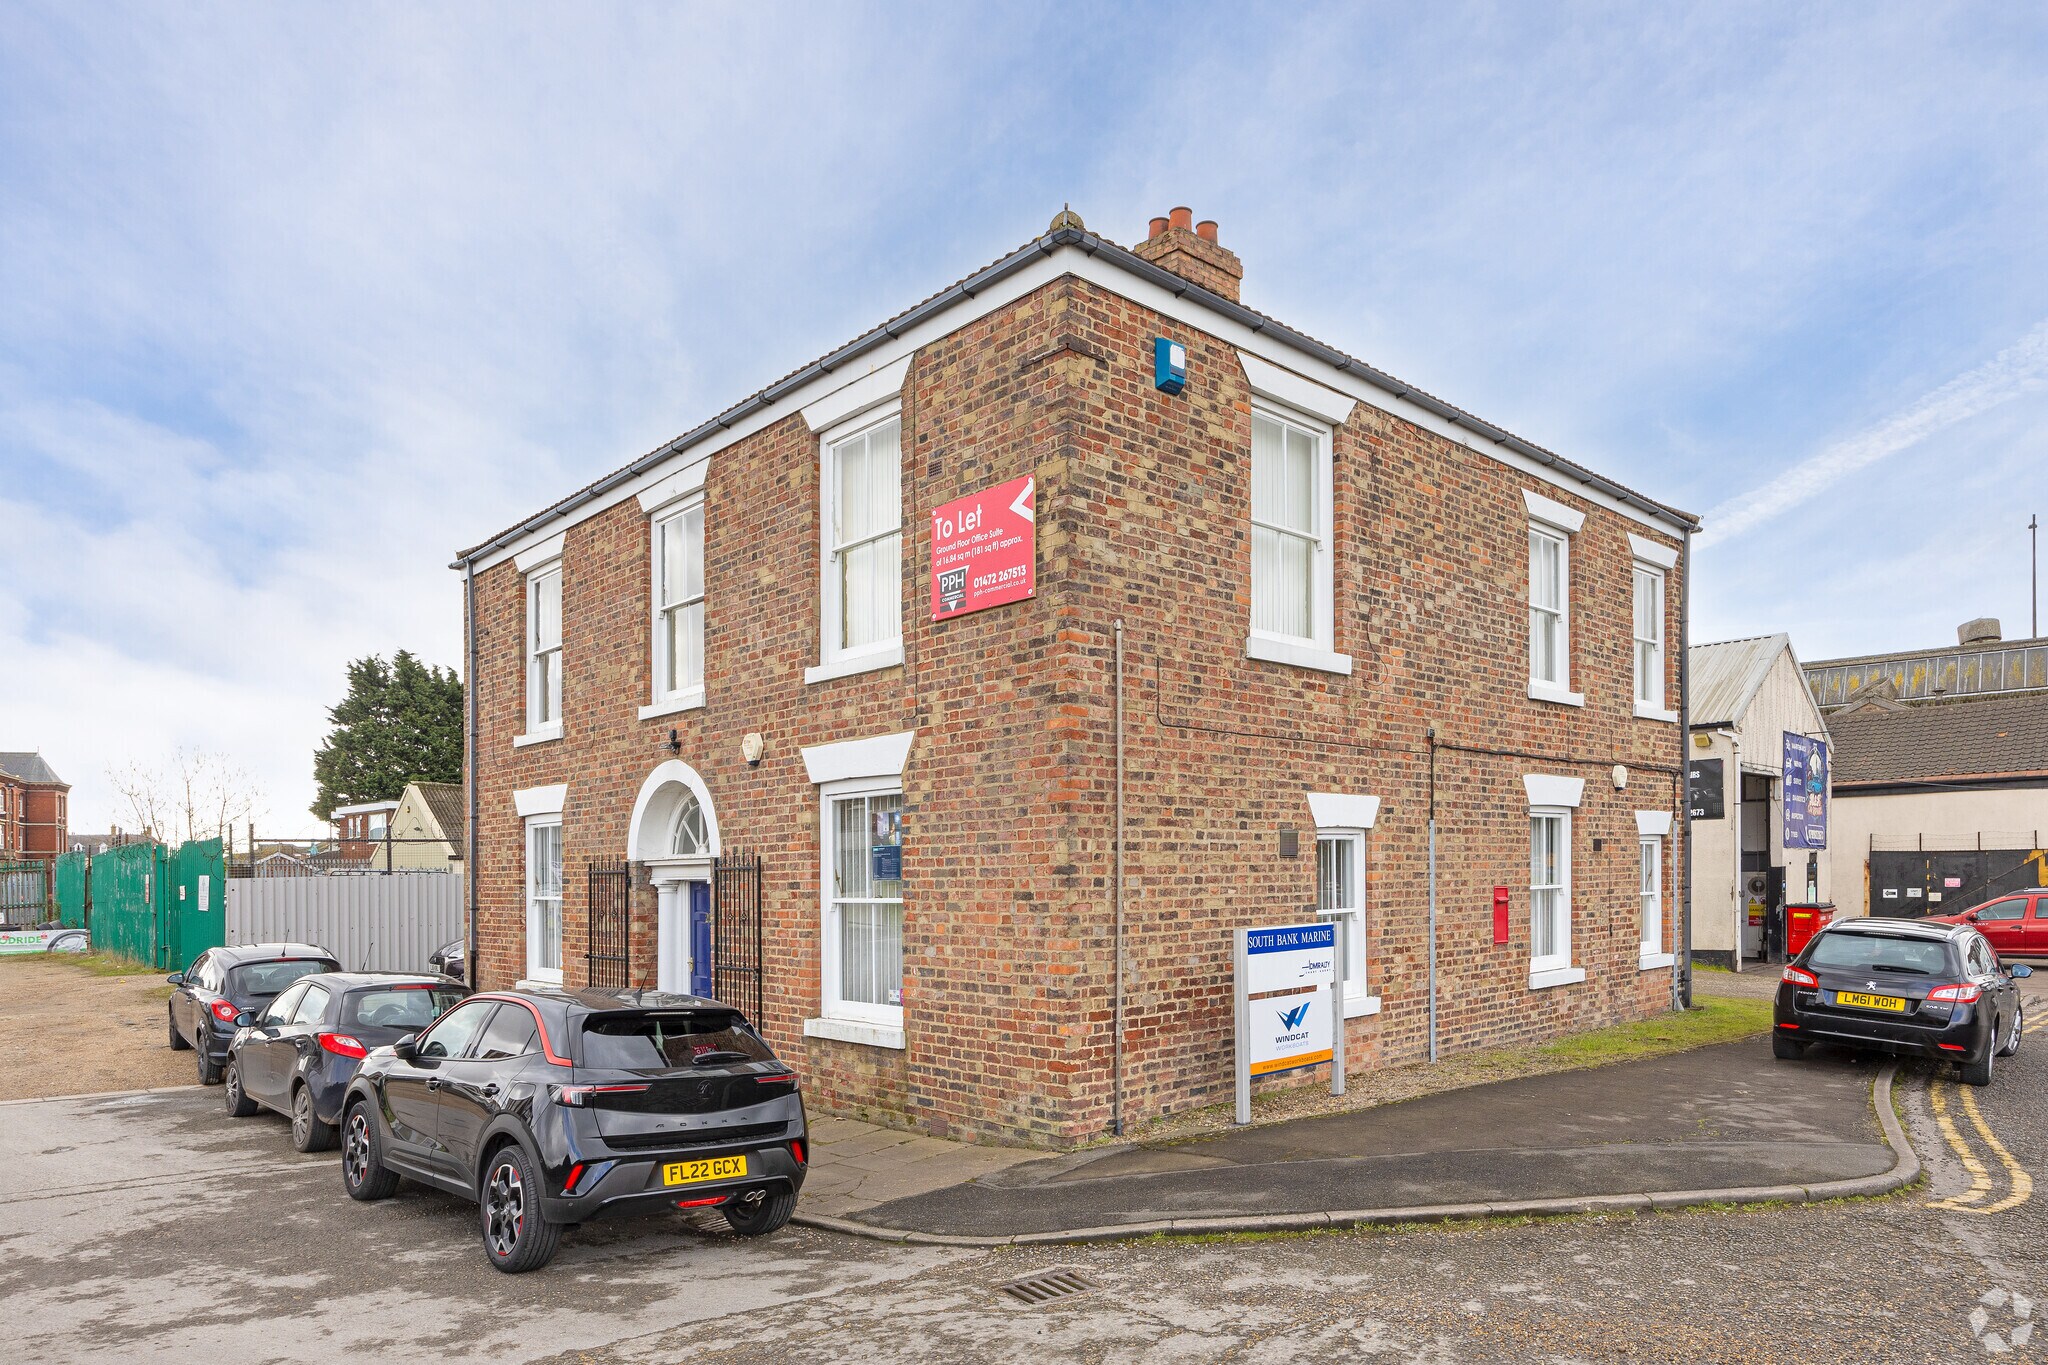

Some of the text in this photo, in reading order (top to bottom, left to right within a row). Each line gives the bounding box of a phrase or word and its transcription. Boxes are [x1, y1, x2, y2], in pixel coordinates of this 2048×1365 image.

[935, 503, 983, 540] To Let
[936, 527, 1004, 555] Ground Floor Office Suite
[936, 557, 942, 567] of
[942, 553, 957, 565] 16.84
[957, 552, 964, 561] sq
[964, 550, 971, 558] m
[971, 545, 983, 558] (181
[984, 544, 992, 553] sq
[999, 535, 1023, 548] approx.
[941, 571, 965, 593] PPH
[973, 564, 1027, 588] 01472 267513
[941, 592, 965, 603] COMMERCIAL
[973, 577, 1026, 598] pph-commercial.co.uk
[1248, 929, 1332, 949] SOUTH BANK MARINE
[1844, 995, 1897, 1008] LM61 WOH
[1275, 1031, 1309, 1044] WINDCAT
[1275, 1041, 1309, 1051] WORKBOATS
[669, 1158, 741, 1182] FL22 GCX
